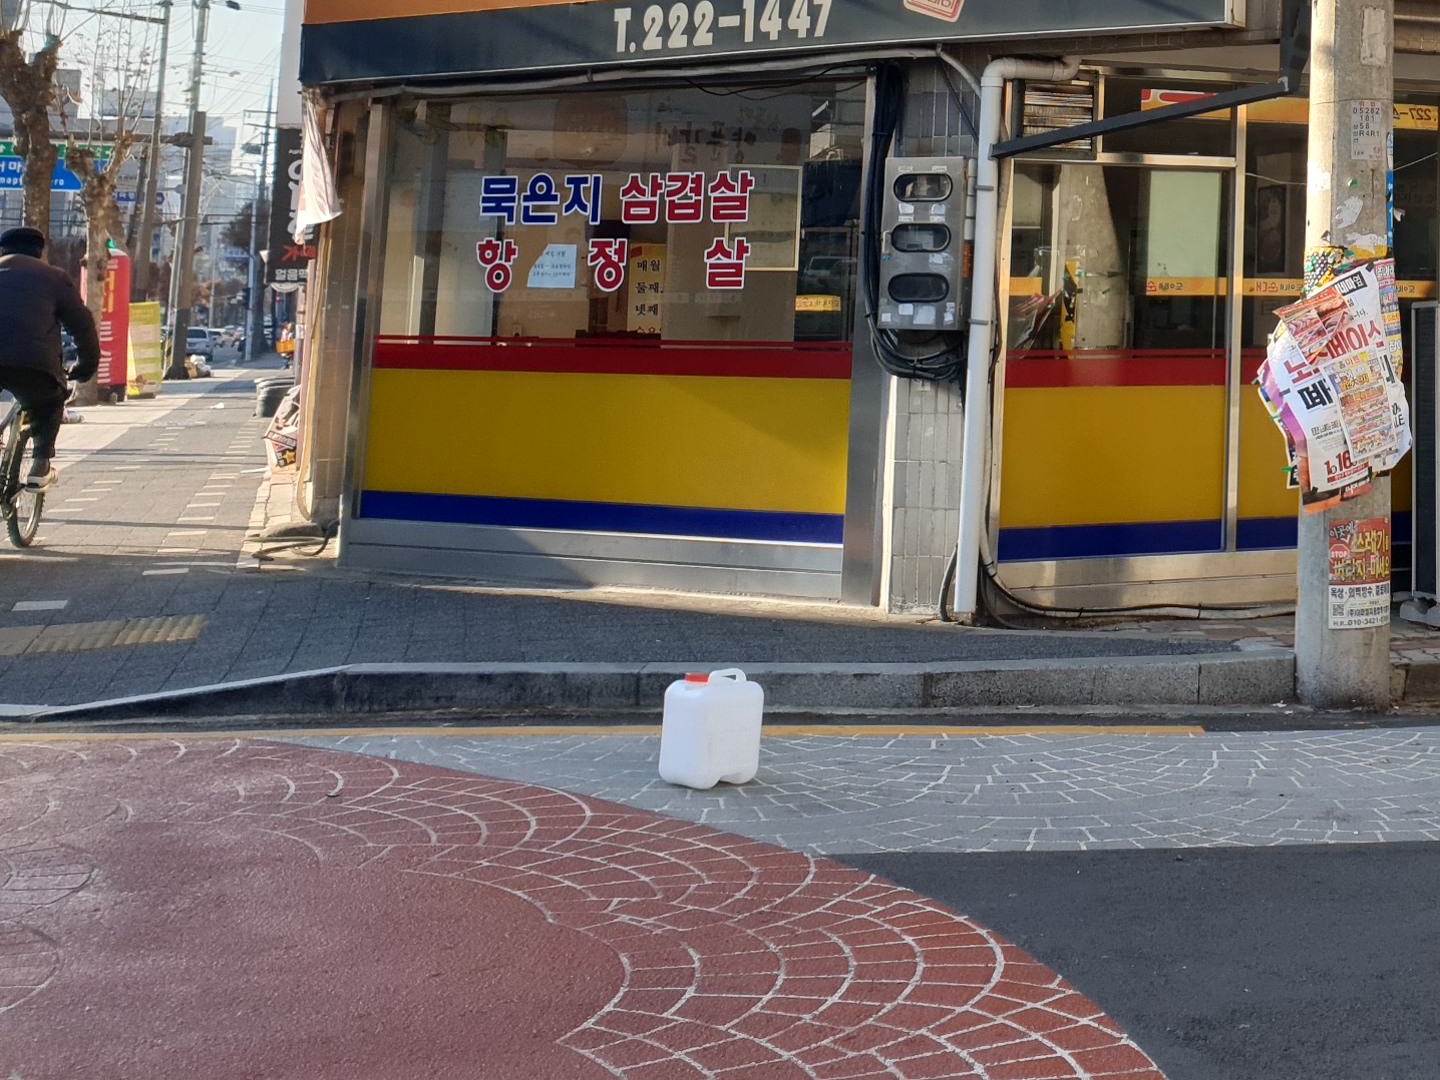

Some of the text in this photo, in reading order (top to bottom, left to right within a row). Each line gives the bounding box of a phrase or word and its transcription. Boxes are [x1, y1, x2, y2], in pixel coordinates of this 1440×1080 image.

[479, 171, 755, 225] 묵은지 삼겹살
[1330, 551, 1348, 559] STOP
